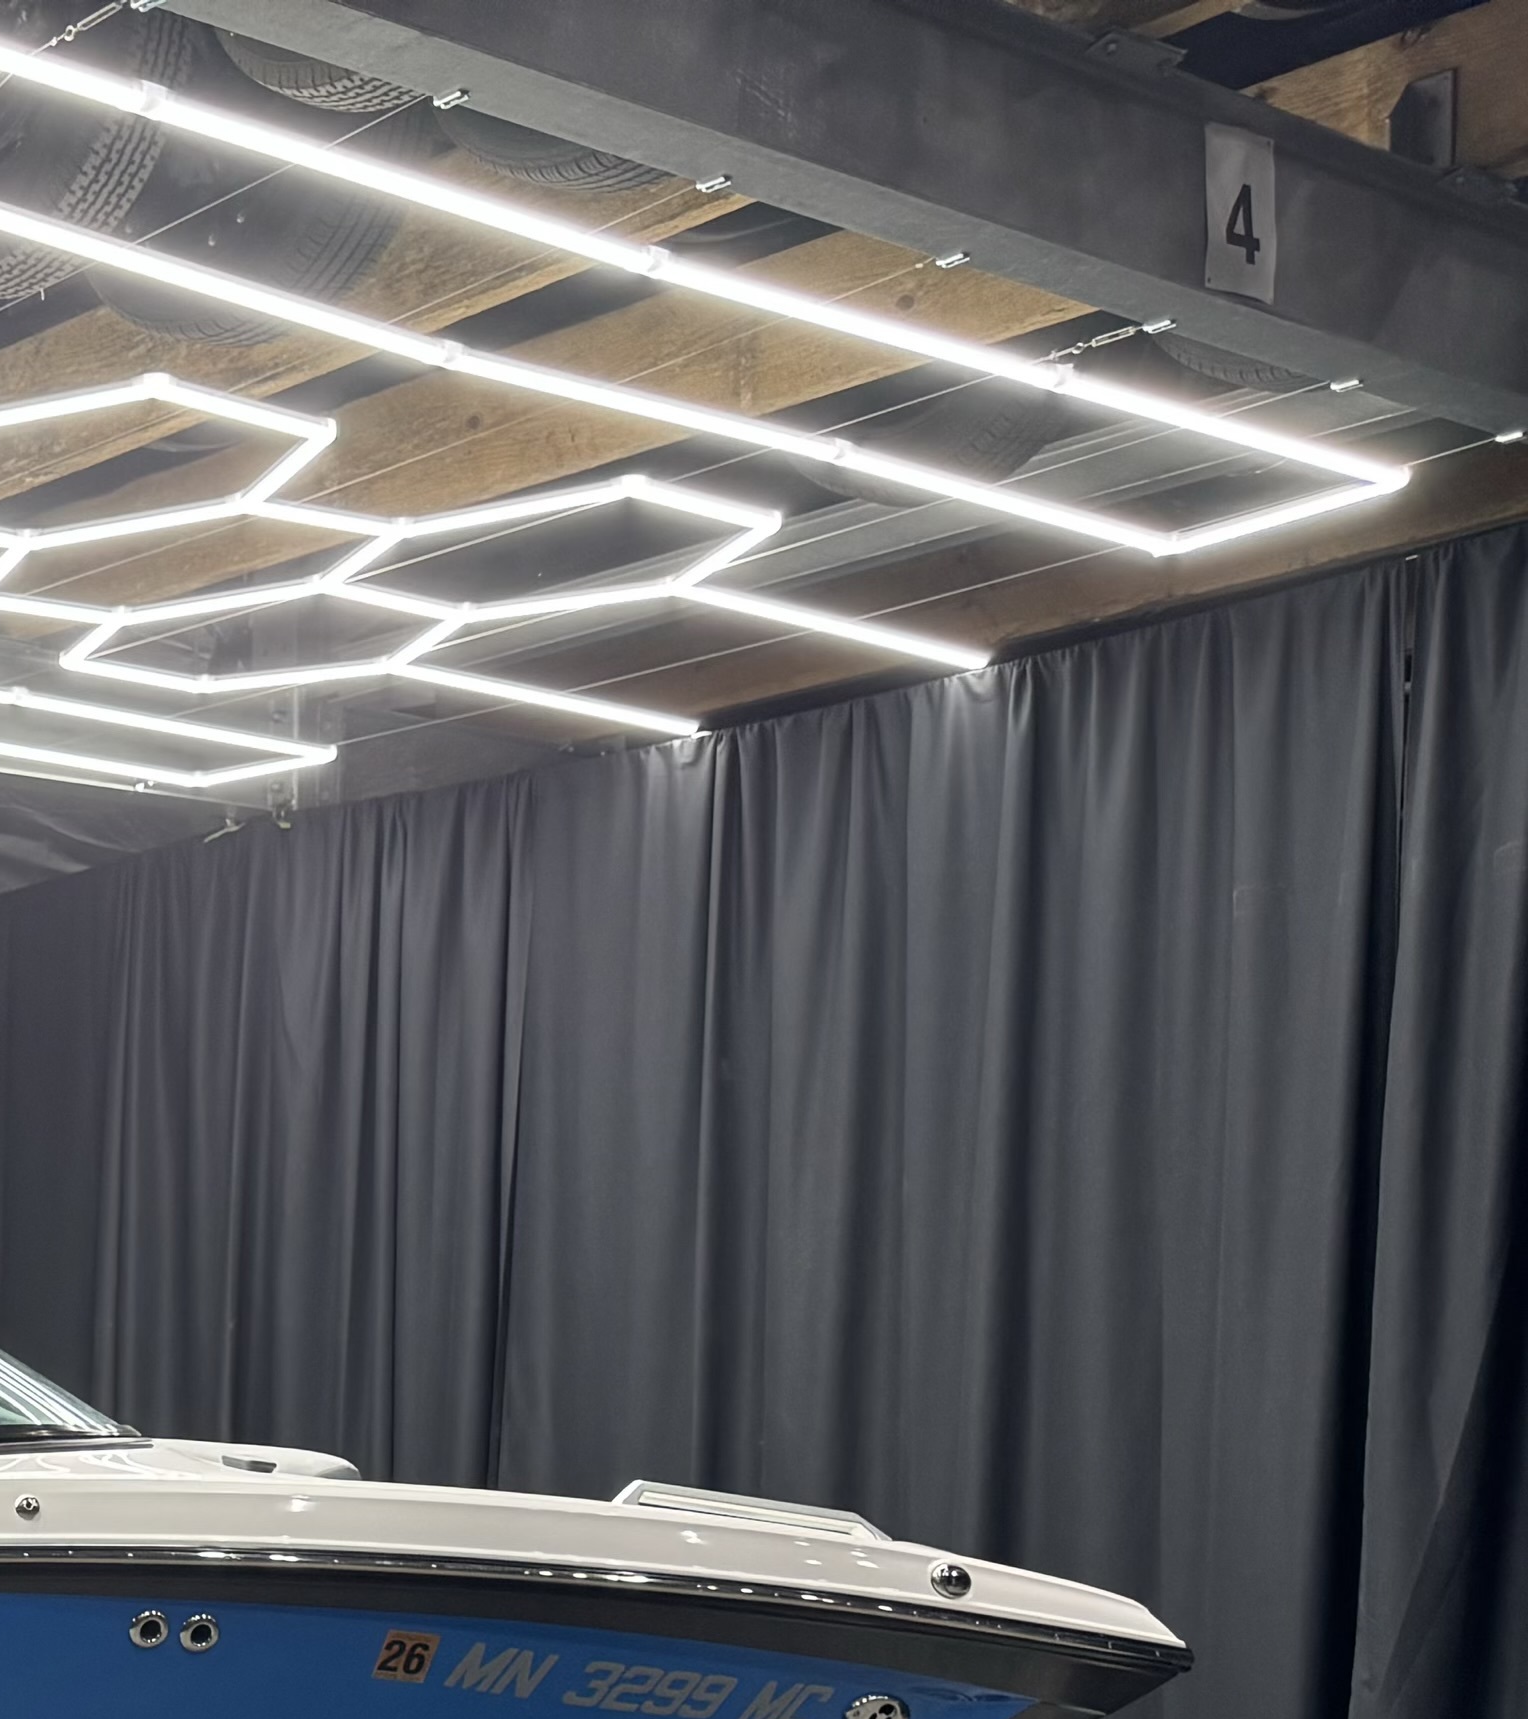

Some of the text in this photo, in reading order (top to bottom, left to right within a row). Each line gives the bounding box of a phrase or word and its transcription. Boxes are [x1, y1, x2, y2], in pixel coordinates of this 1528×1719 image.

[1226, 184, 1260, 265] 4
[377, 1640, 429, 1674] 26
[445, 1643, 559, 1698] MN
[562, 1661, 737, 1718] 3299
